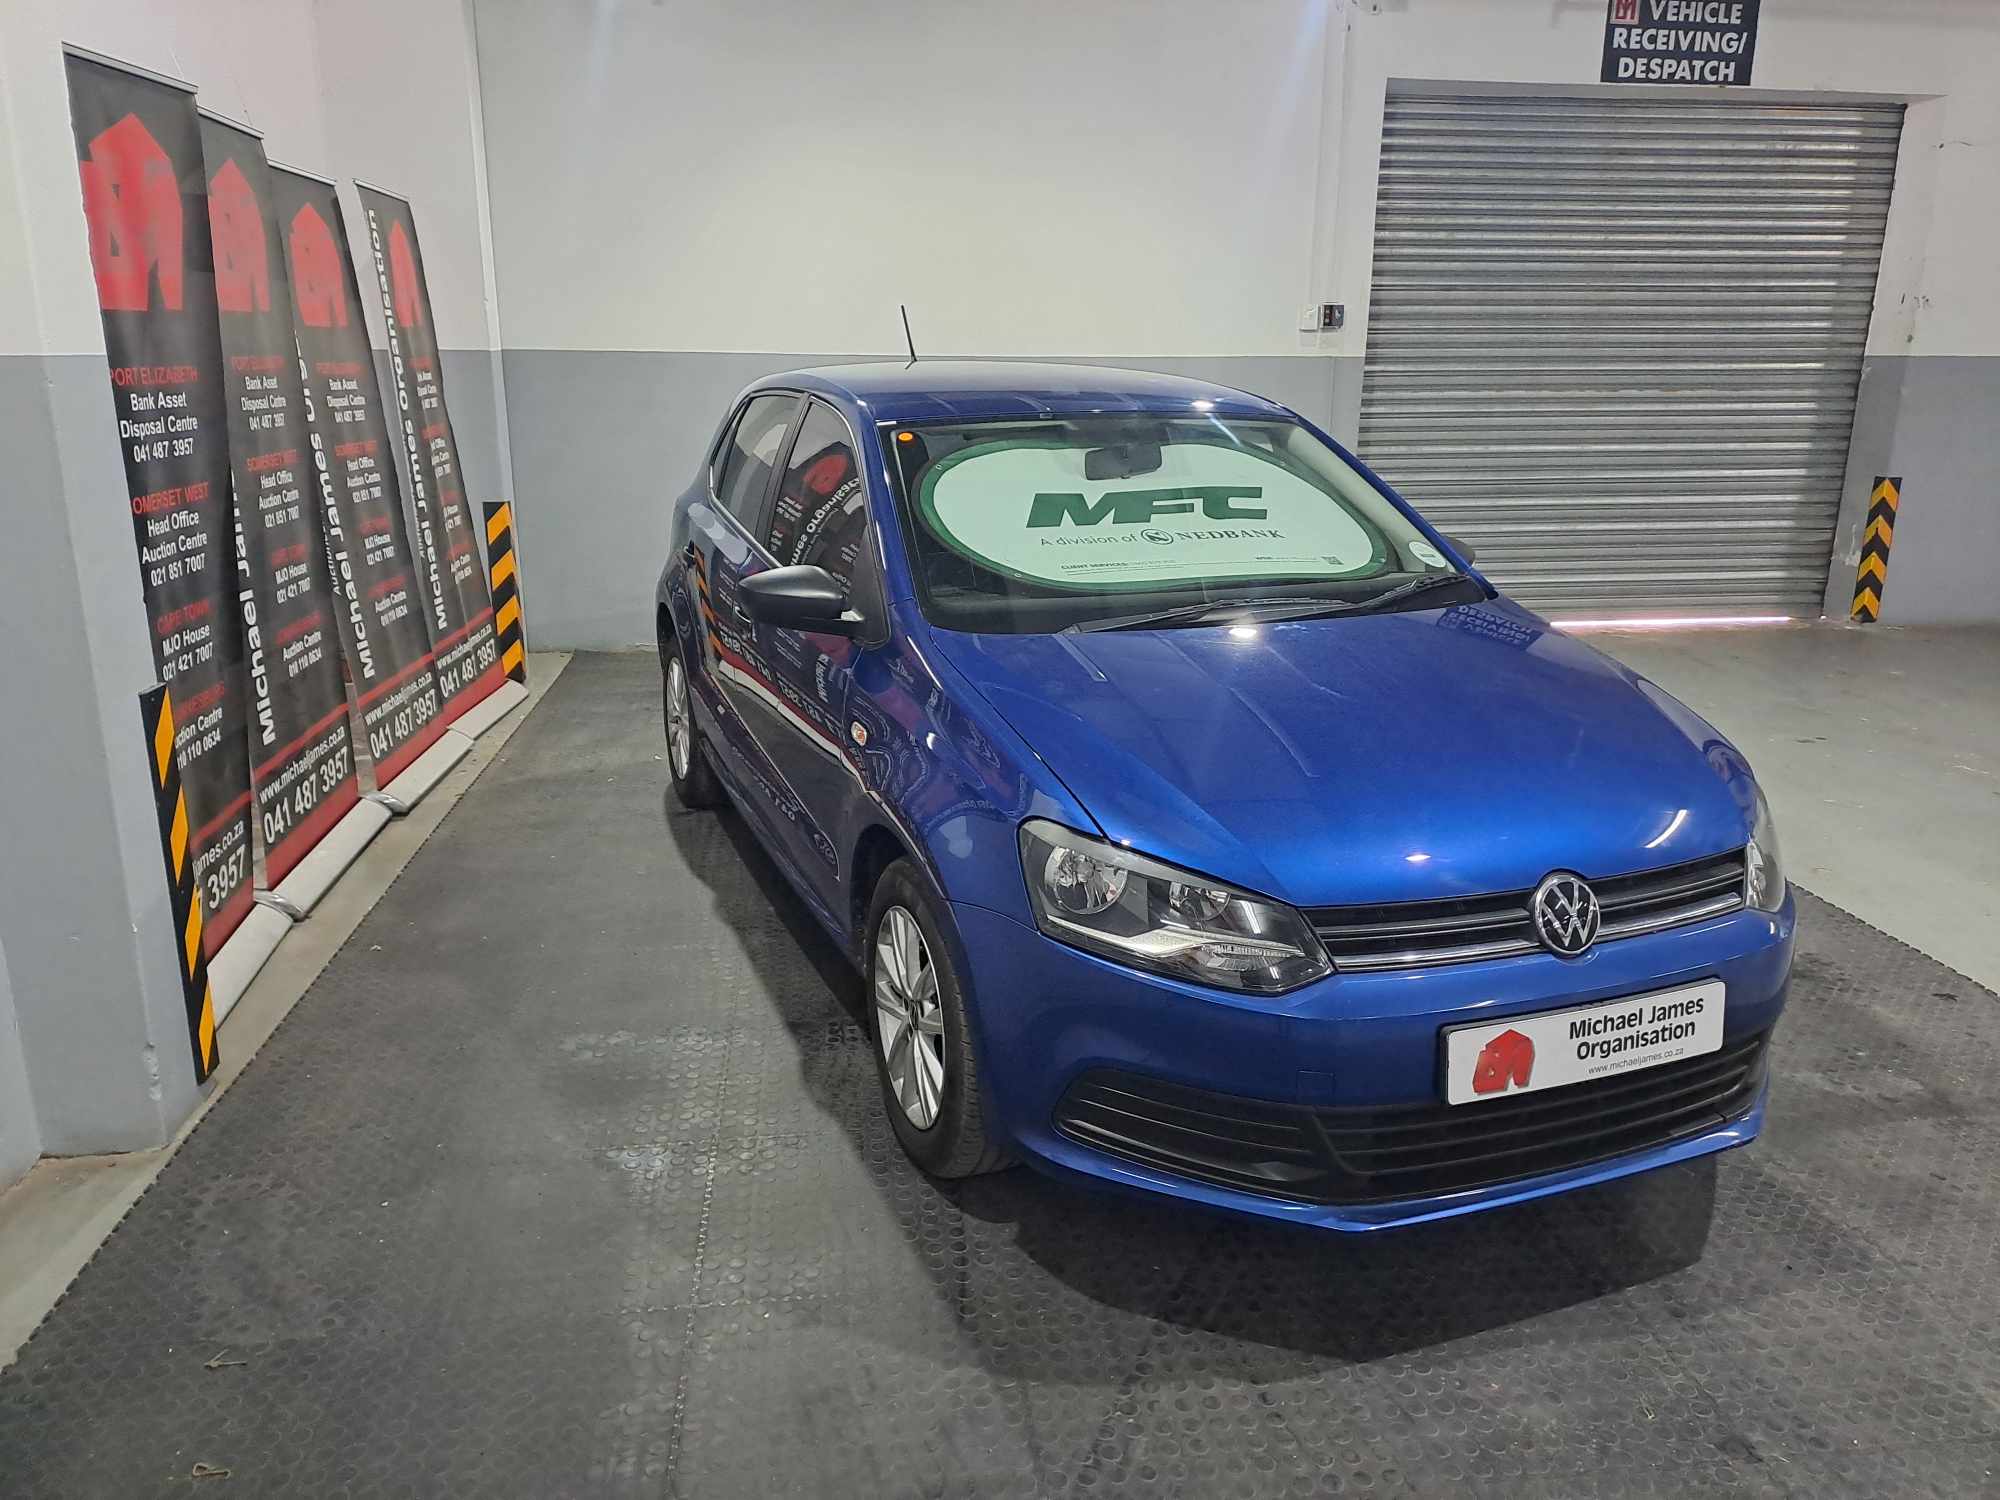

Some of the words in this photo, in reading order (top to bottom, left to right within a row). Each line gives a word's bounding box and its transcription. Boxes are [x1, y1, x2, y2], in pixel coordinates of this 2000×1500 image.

[1651, 0, 1744, 25] VEHICLE
[1612, 27, 1748, 54] RECEIVING/
[1617, 57, 1736, 82] DESPATCH
[130, 392, 156, 411] Bank
[157, 391, 188, 409] Asset
[120, 416, 166, 440] Disposal
[167, 414, 199, 433] Centre
[133, 444, 151, 463] 041
[152, 441, 169, 459] 487
[172, 437, 194, 457] 3957
[404, 418, 428, 513] James
[132, 488, 183, 514] OMERSET
[258, 493, 282, 511] Auction
[309, 432, 345, 542] James
[147, 515, 170, 538] Head
[171, 510, 199, 530] Office
[1026, 486, 1268, 528] MFC
[141, 541, 177, 565] Auction
[178, 531, 208, 552] Centre
[1040, 537, 1053, 547] A
[1056, 534, 1120, 547] division
[1121, 532, 1139, 544] of
[1174, 527, 1287, 542] NEDBANK
[150, 566, 167, 587] 021
[168, 559, 183, 580] 851
[184, 552, 206, 574] 7007
[420, 519, 448, 631] Michael
[335, 551, 376, 680] Michael
[162, 633, 182, 657] MJO
[182, 624, 211, 647] House
[162, 660, 177, 681] 021
[177, 652, 194, 672] 421
[194, 641, 213, 665] 7007
[239, 589, 277, 746] Michael
[439, 671, 460, 699] 041
[461, 659, 478, 686] 487
[477, 637, 497, 672] 3957
[197, 706, 223, 731] Centre
[369, 726, 394, 759] 041
[393, 706, 413, 742] 487
[412, 688, 437, 726] 3957
[202, 727, 222, 752] 0634
[259, 725, 346, 804] www.michaeljames.co.za
[262, 802, 292, 845] 041
[293, 774, 318, 816] 487
[319, 746, 350, 792] 3957
[207, 843, 246, 910] 3957
[1568, 1007, 1644, 1040] Michael
[1646, 996, 1705, 1025] James
[1576, 1019, 1696, 1061] Organisation
[1588, 1047, 1685, 1076] www.michaeljames.co.za
